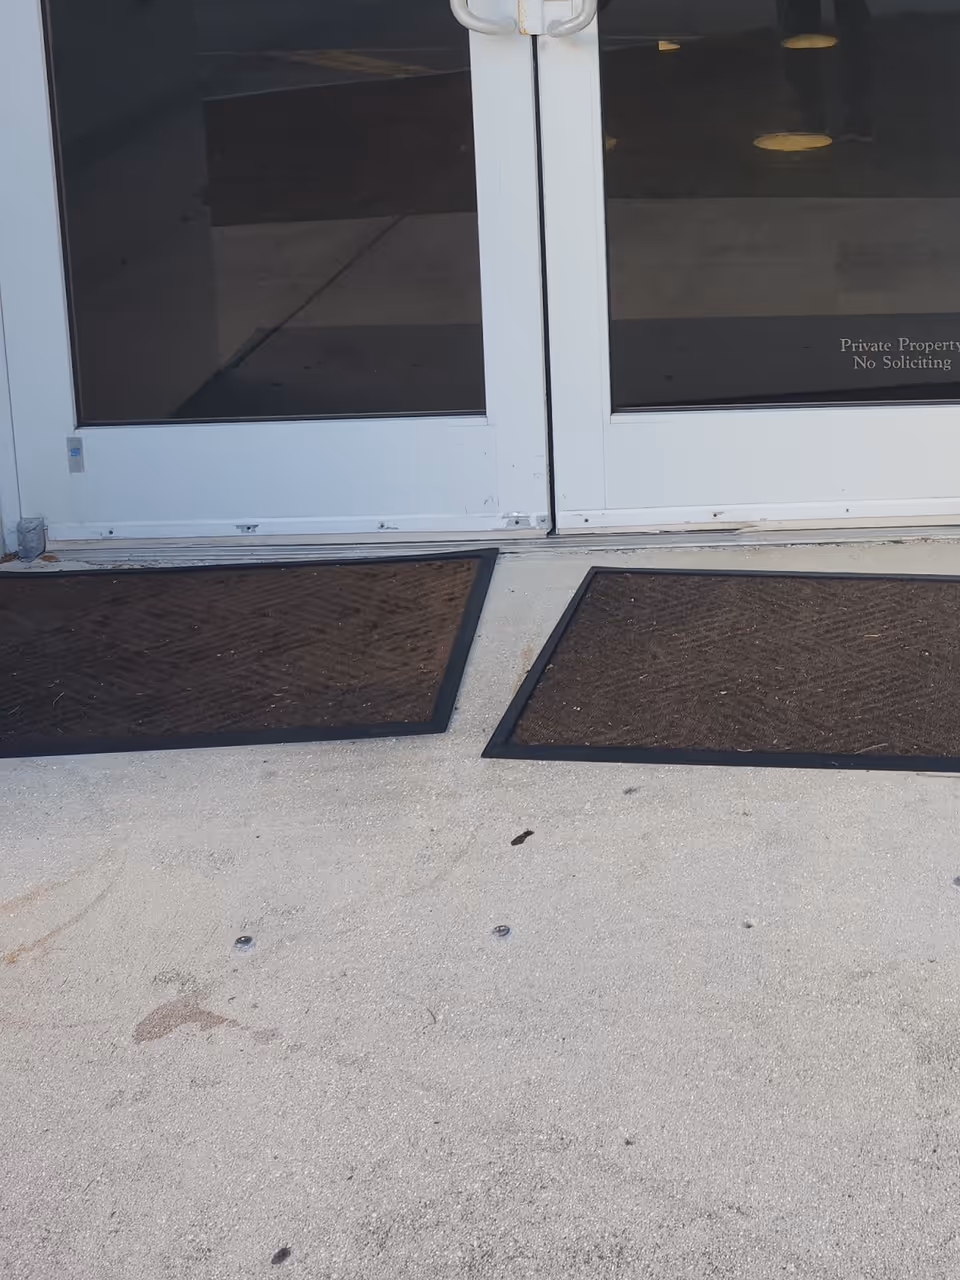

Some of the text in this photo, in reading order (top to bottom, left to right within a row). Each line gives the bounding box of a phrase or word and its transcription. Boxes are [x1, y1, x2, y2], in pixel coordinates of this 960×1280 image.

[840, 338, 892, 352] Private
[853, 355, 952, 371] No Soliciting
